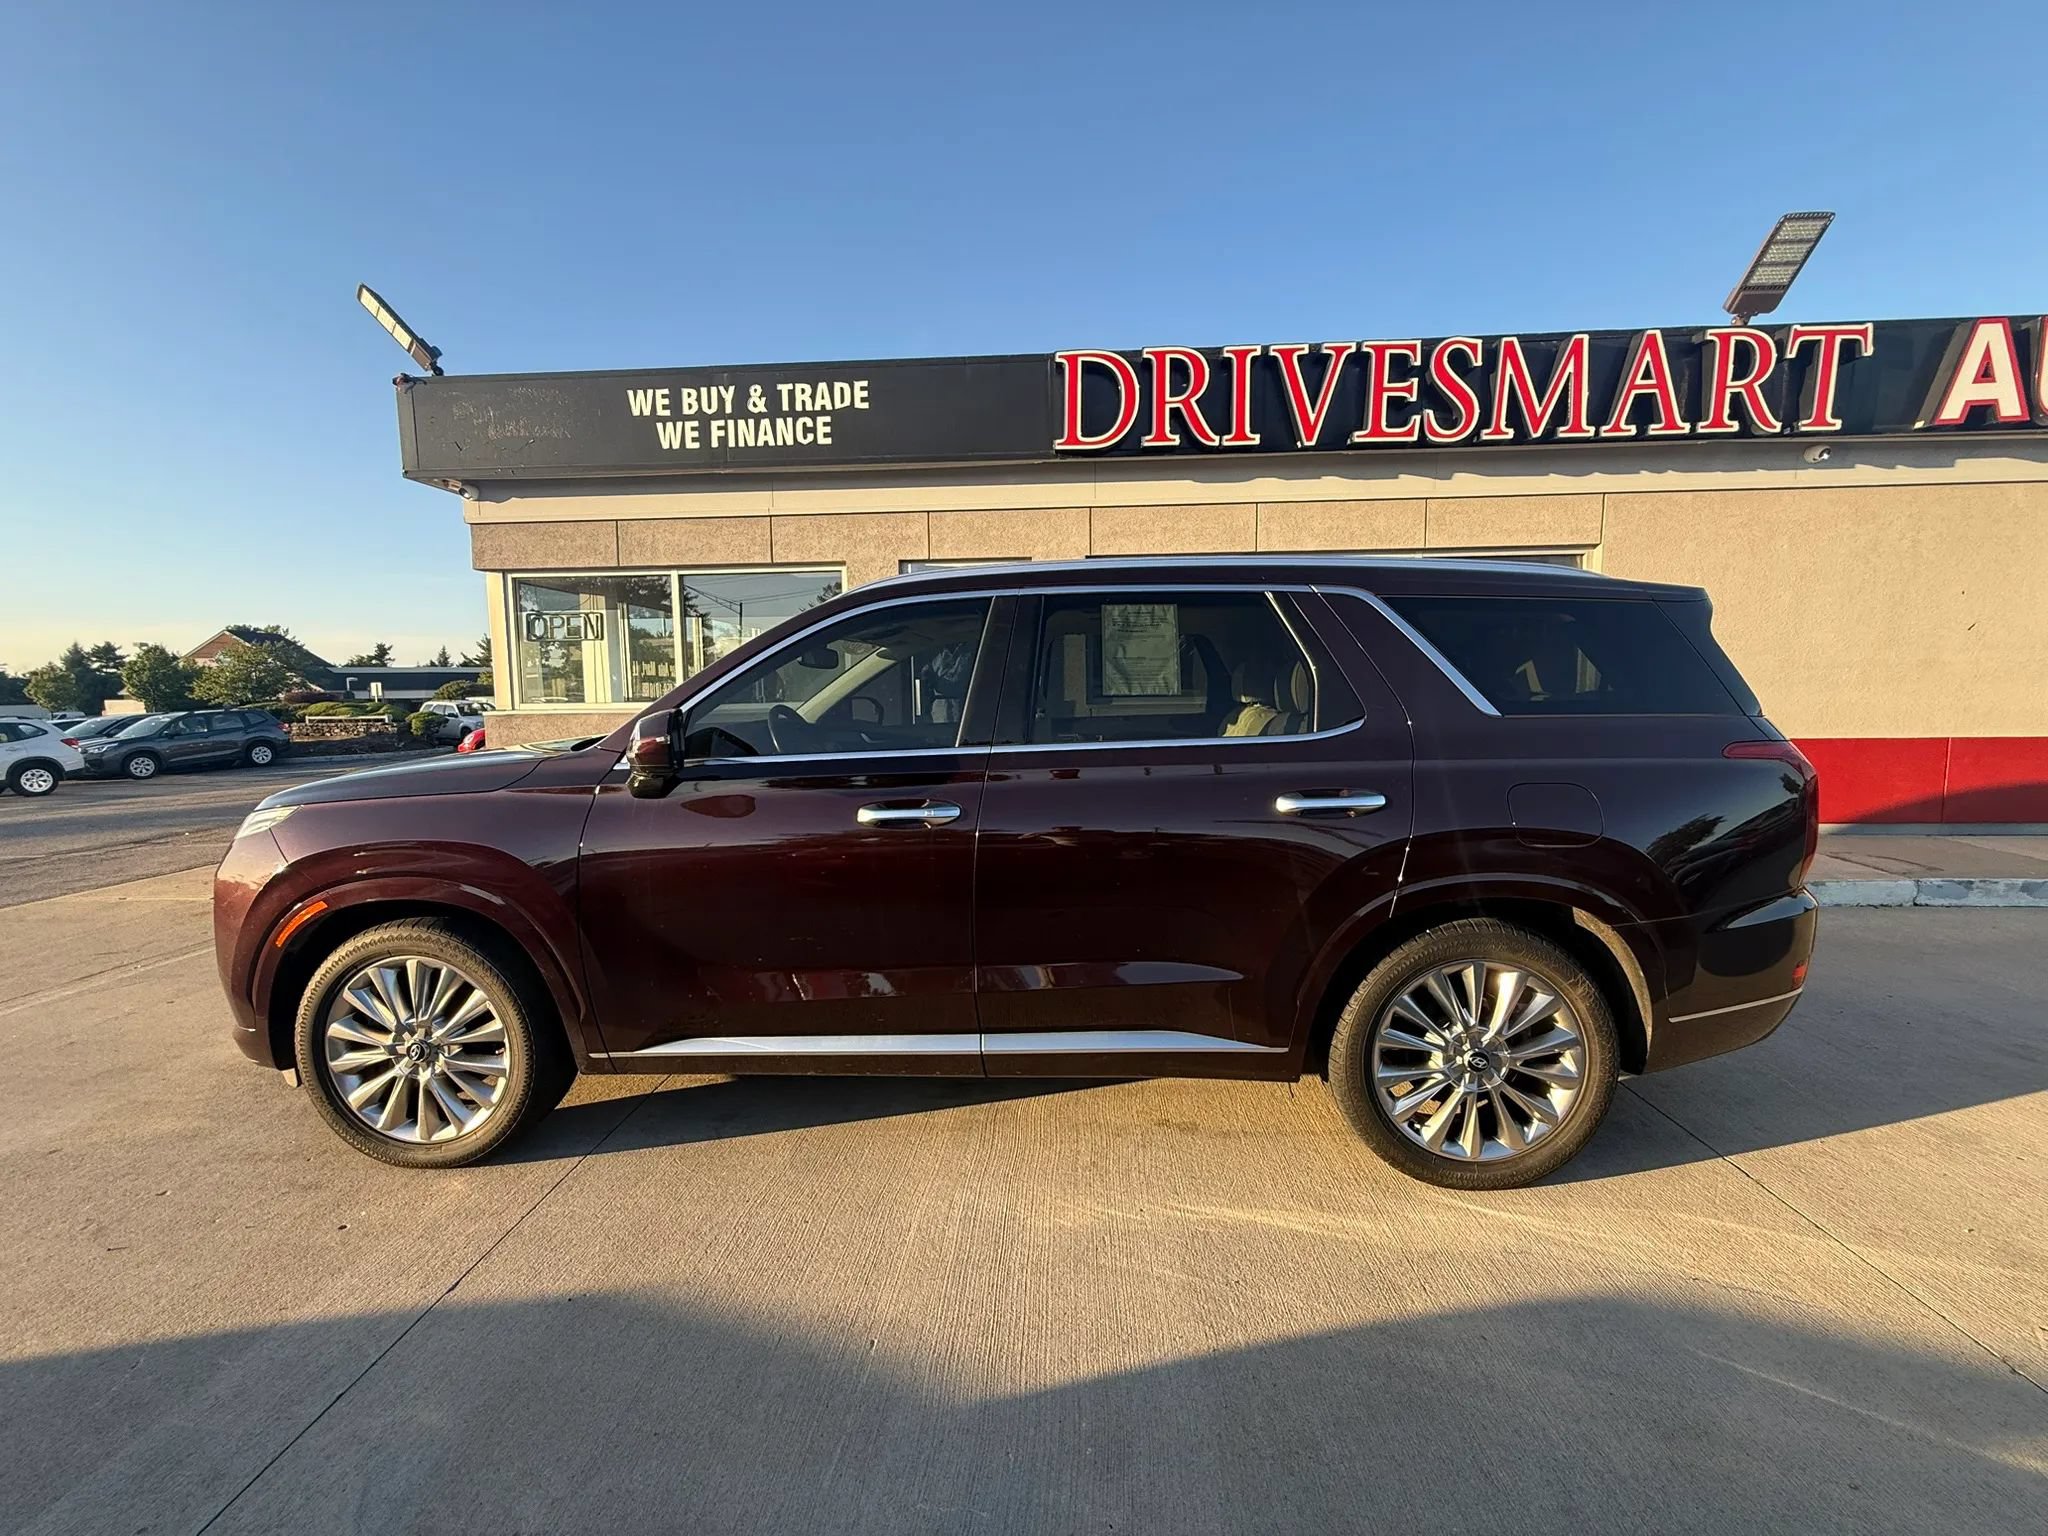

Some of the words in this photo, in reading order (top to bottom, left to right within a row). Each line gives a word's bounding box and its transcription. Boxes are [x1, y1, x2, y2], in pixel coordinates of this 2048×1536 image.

[626, 388, 671, 417] WE
[681, 384, 736, 415] BUY
[747, 383, 768, 414] &
[776, 380, 870, 412] TRADE
[1054, 323, 1873, 450] DRIVESMART
[1934, 315, 2048, 425] A
[656, 420, 700, 450] WE
[710, 416, 832, 448] FINANCE
[528, 613, 600, 640] OPEN
